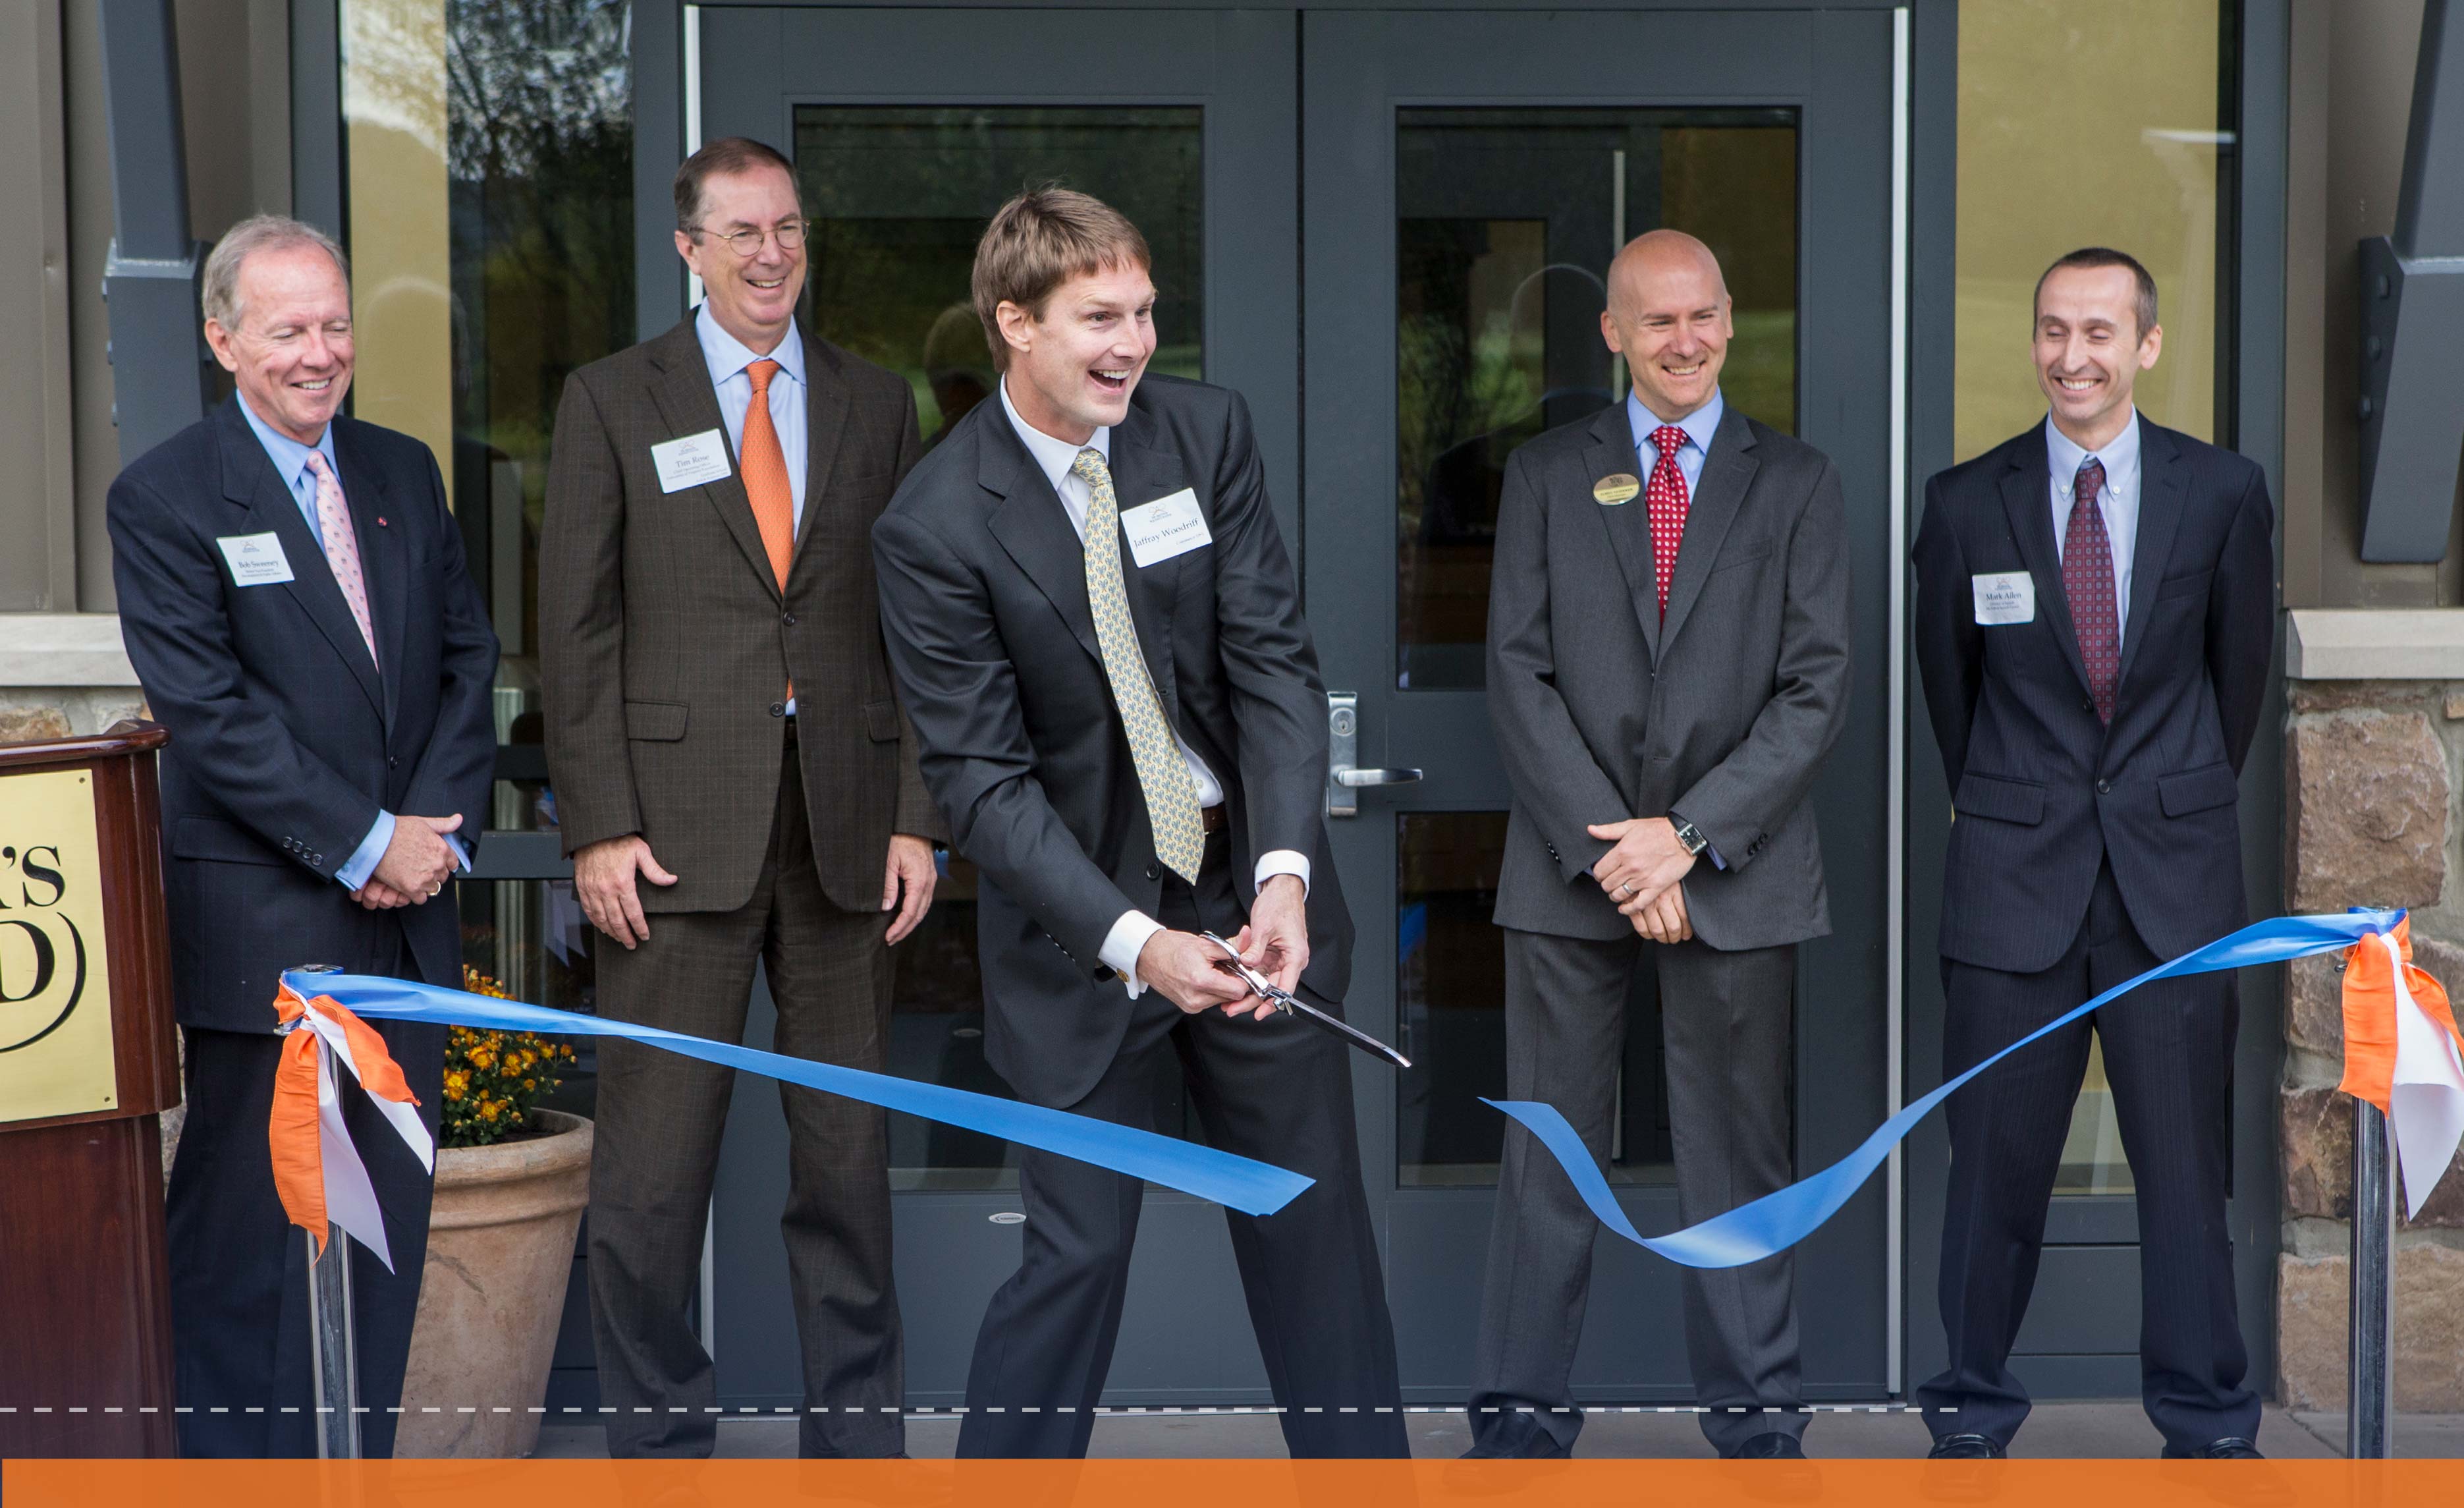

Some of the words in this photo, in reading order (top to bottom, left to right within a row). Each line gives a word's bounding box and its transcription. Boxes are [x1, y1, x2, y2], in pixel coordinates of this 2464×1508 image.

[674, 460, 691, 468] Tim
[692, 455, 710, 464] Rose
[1134, 532, 1160, 548] Jaffray
[1161, 518, 1199, 538] Woodriff
[252, 560, 279, 569] Sweeney
[1986, 592, 2003, 601] Mark
[2004, 592, 2022, 600] Allen
[0, 846, 66, 908] 'S
